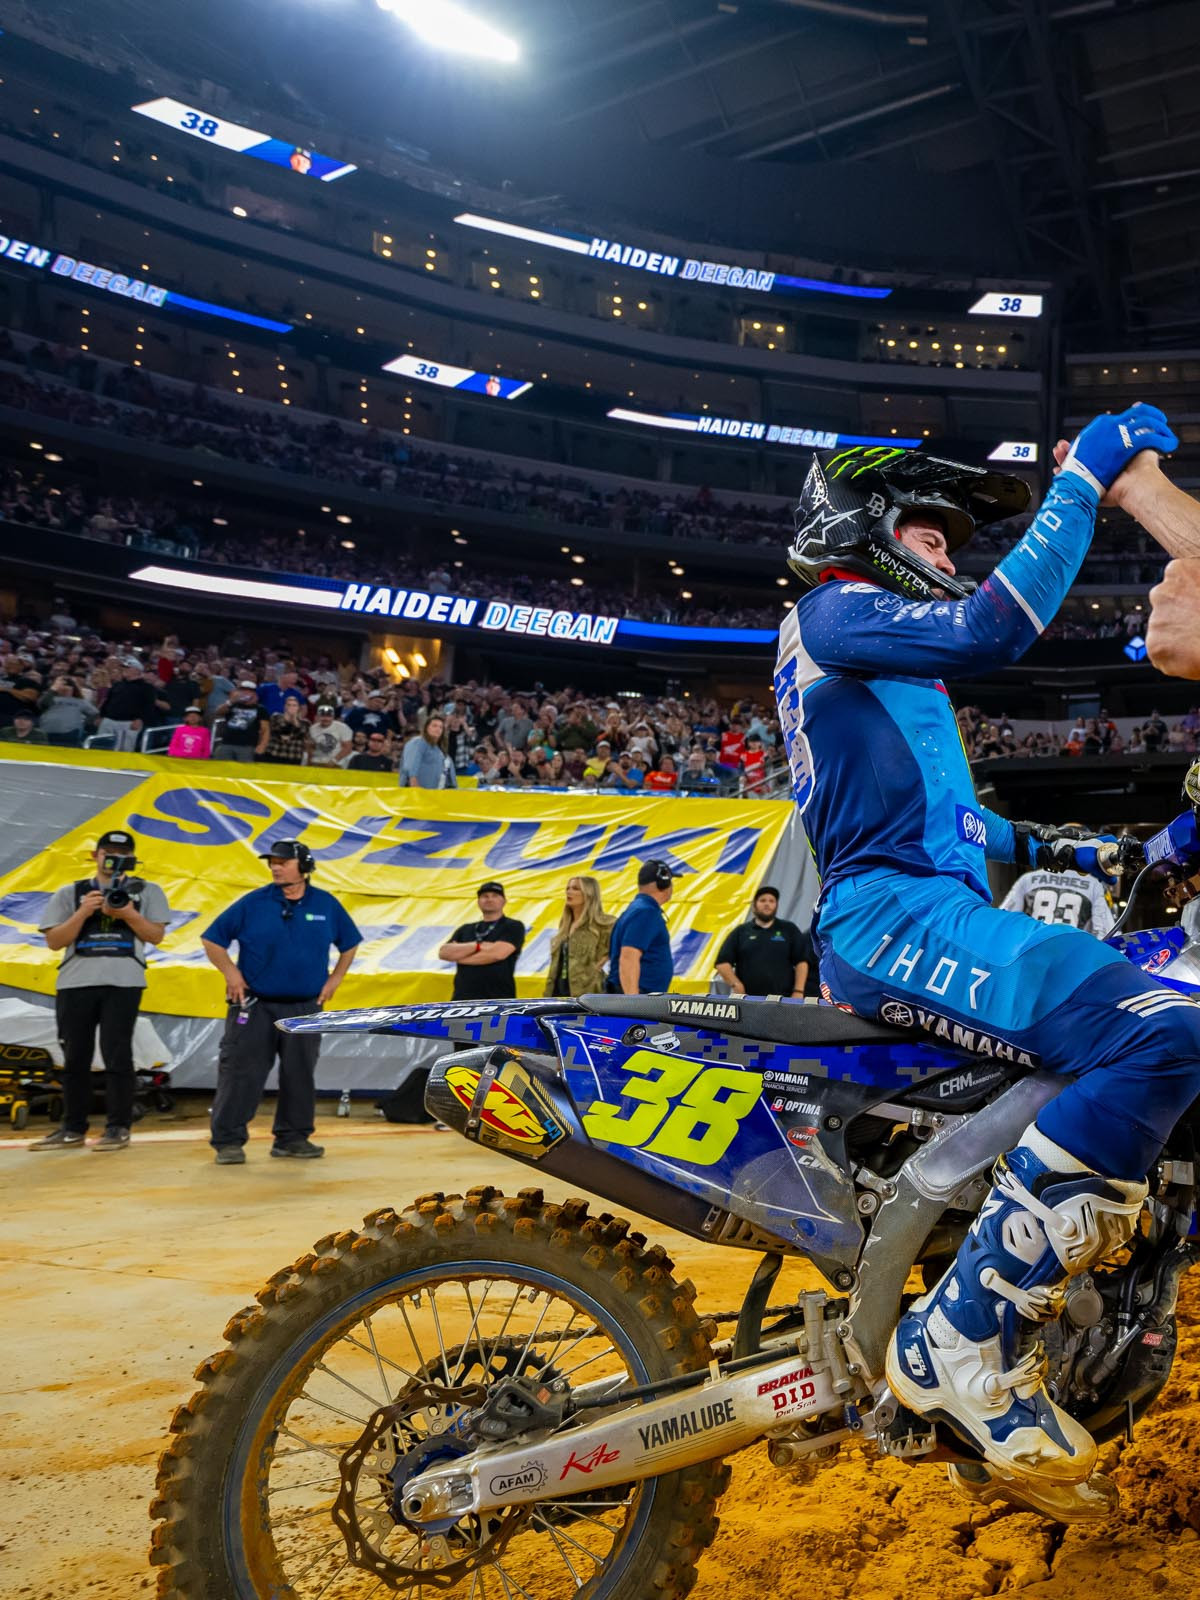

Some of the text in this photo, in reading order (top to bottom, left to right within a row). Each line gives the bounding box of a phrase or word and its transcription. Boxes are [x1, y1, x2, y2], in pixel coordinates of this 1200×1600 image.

[180, 111, 220, 138] 38
[589, 237, 776, 292] HAIDEN DEEGAN
[51, 253, 169, 307] DEEGAN
[998, 297, 1022, 314] 38
[414, 362, 440, 380] 38
[697, 415, 839, 450] HAIDEN DEEGAN
[1011, 445, 1031, 458] 38
[873, 558, 918, 593] ENERGY
[341, 583, 619, 645] HAIDEN DEEGAN
[127, 788, 763, 876] SUZUKI
[1031, 874, 1090, 891] FARRES
[1030, 889, 1083, 924] 83
[333, 1004, 499, 1026] DUNLOP
[669, 1000, 738, 1021] YAMAHA
[917, 1009, 1037, 1069] YAMAHA
[762, 1083, 808, 1094] FINANCIAL SERVICES
[774, 1071, 809, 1086] YAMAHA
[939, 1071, 975, 1099] CRM
[444, 1069, 549, 1139] FMF
[582, 1050, 764, 1166] 38
[785, 1100, 821, 1115] OPTIMA
[637, 1397, 738, 1451] YAMALUBE
[498, 1471, 535, 1491] AFAM
